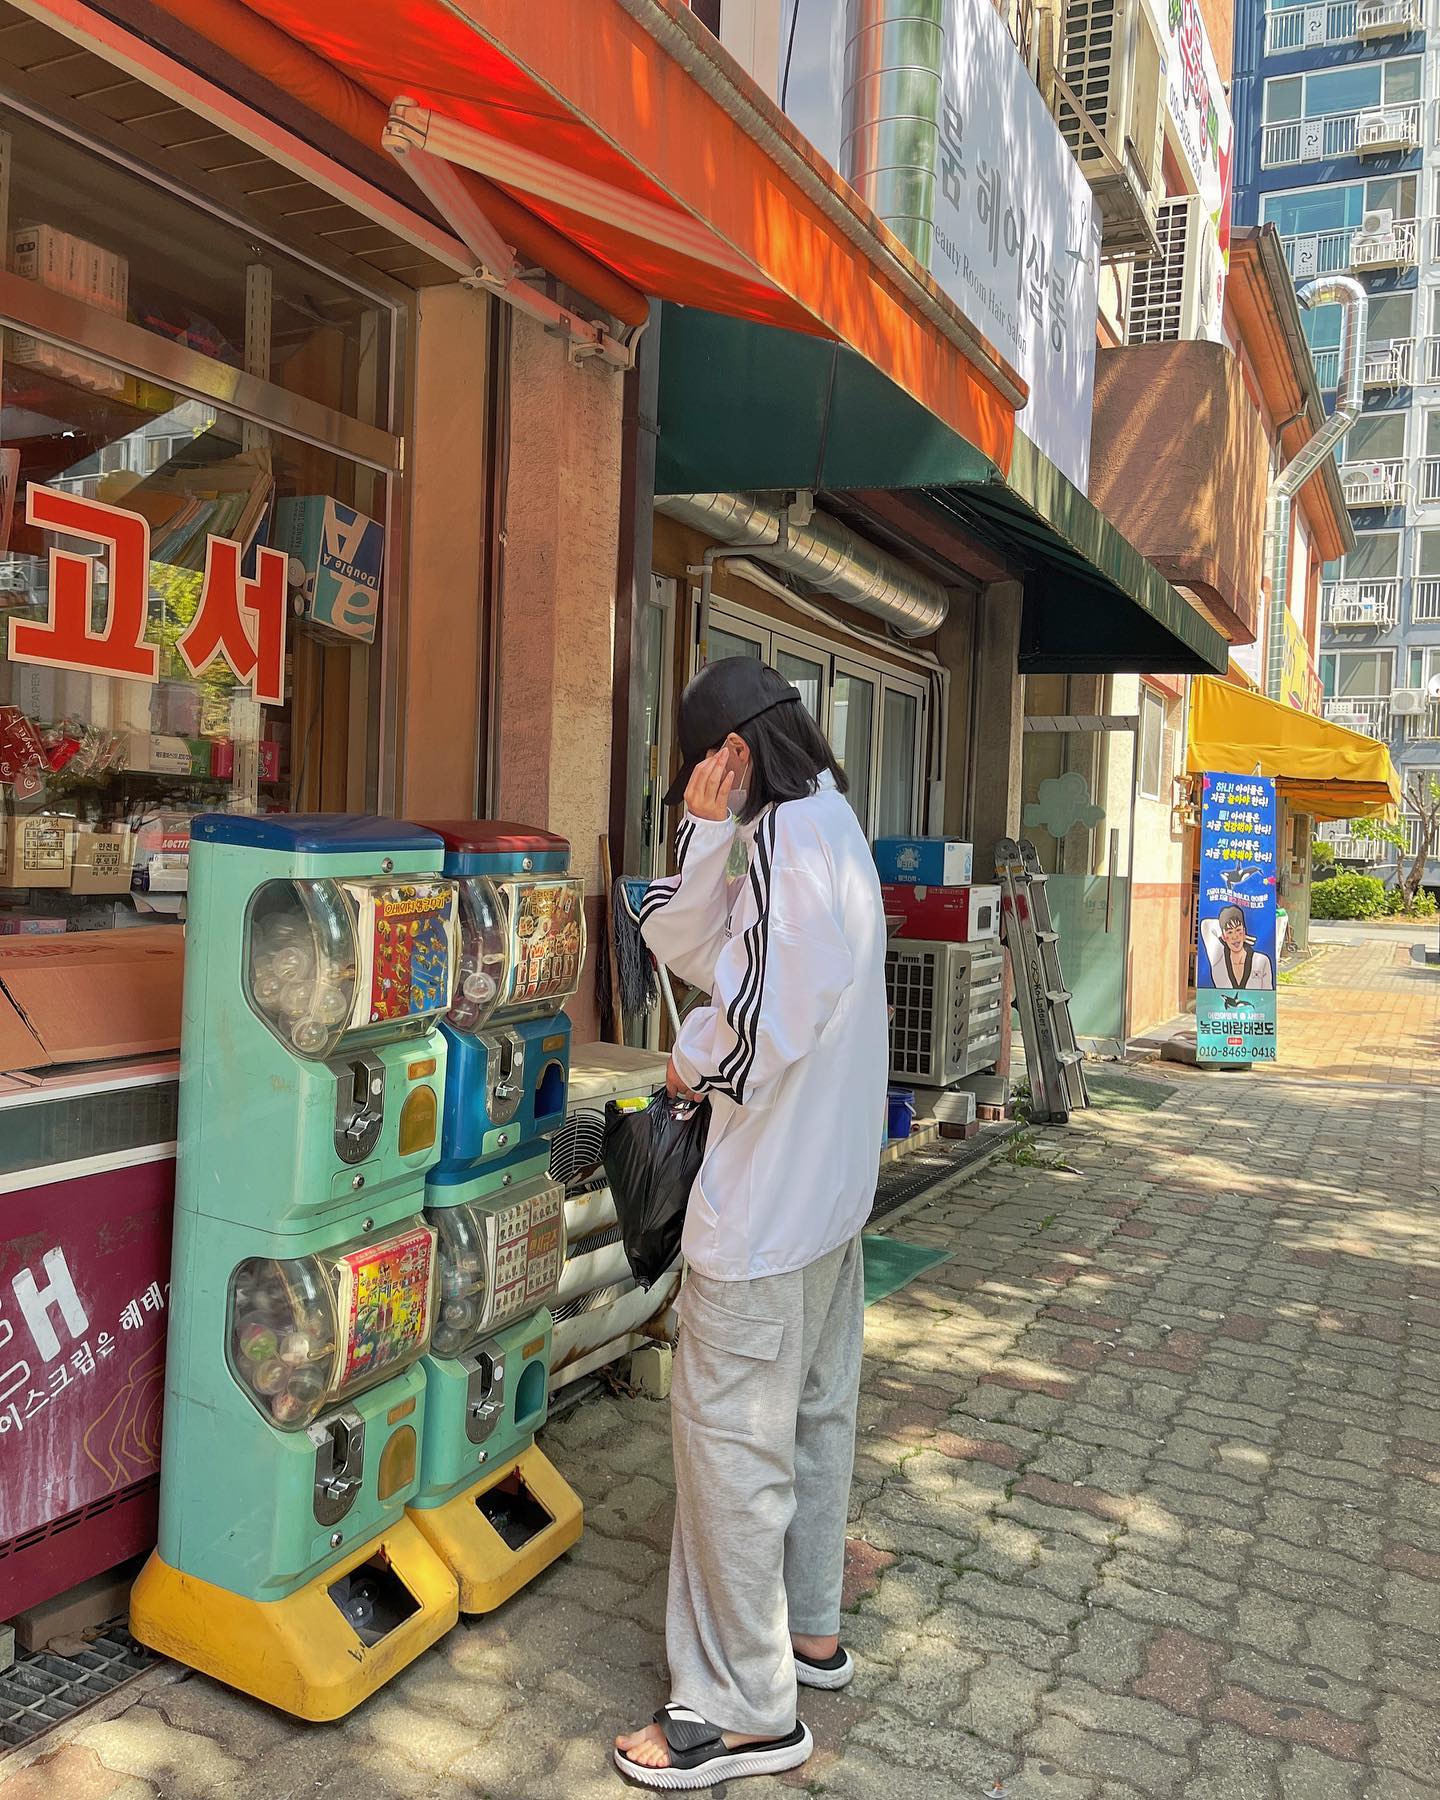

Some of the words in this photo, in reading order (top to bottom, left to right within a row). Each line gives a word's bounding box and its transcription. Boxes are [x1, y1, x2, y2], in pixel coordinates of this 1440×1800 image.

[934, 224, 961, 275] eauty
[963, 255, 988, 300] Room
[988, 287, 1006, 328] Hair
[1006, 312, 1028, 356] Salon
[322, 552, 331, 566] A
[335, 558, 377, 588] Double
[1216, 781, 1234, 793] 하나!
[1235, 784, 1264, 796] 아이들은
[1210, 793, 1226, 804] 지금
[1251, 796, 1269, 807] 한다!
[1230, 811, 1260, 823] 아이들은
[1206, 820, 1222, 831] 지금
[1254, 824, 1272, 835] 한다!
[161, 839, 190, 849] LOCTIT
[1230, 839, 1260, 851] 아이들은
[1205, 848, 1221, 859] 지금
[1254, 852, 1272, 862] 한다!
[1200, 1020, 1275, 1036] 높은바람태권도
[1199, 1046, 1276, 1058] 010-8469-0418
